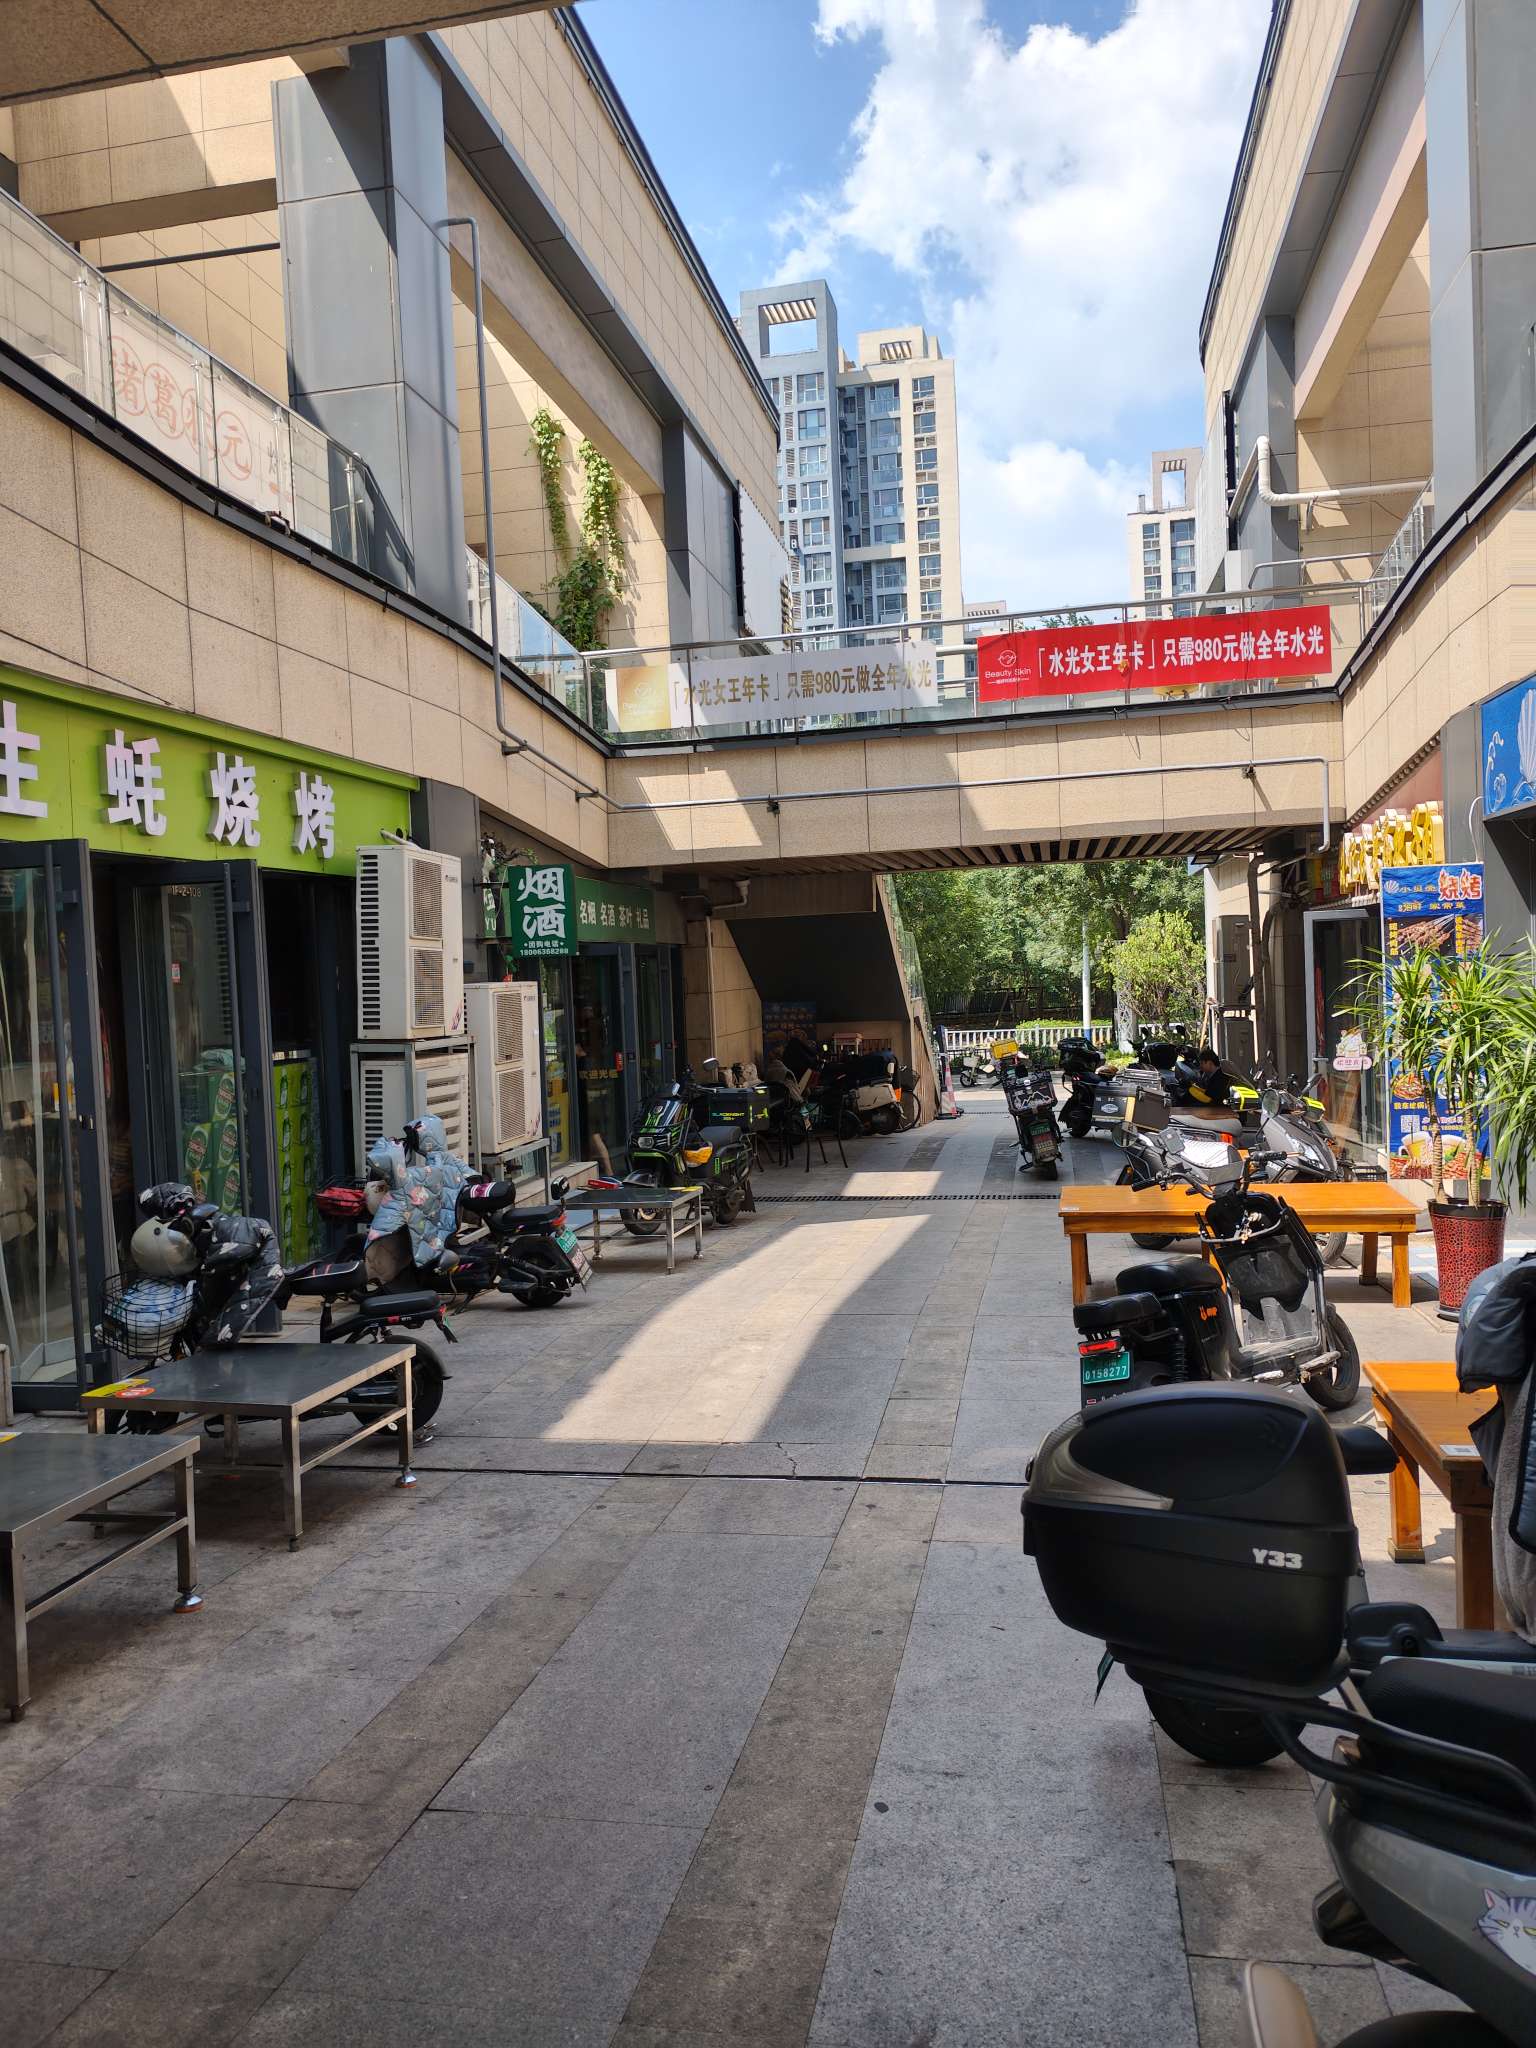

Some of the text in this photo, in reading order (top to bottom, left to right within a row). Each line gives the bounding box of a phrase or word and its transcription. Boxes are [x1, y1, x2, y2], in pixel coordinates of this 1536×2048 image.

[985, 667, 1031, 678] Beauty Skin
[1439, 870, 1482, 900] 烧烤
[516, 867, 566, 939] 烟酒
[579, 899, 597, 925] 名烟
[600, 902, 616, 926] 名酒
[1085, 1366, 1127, 1380] 0158277
[1251, 1547, 1304, 1571] Y33
